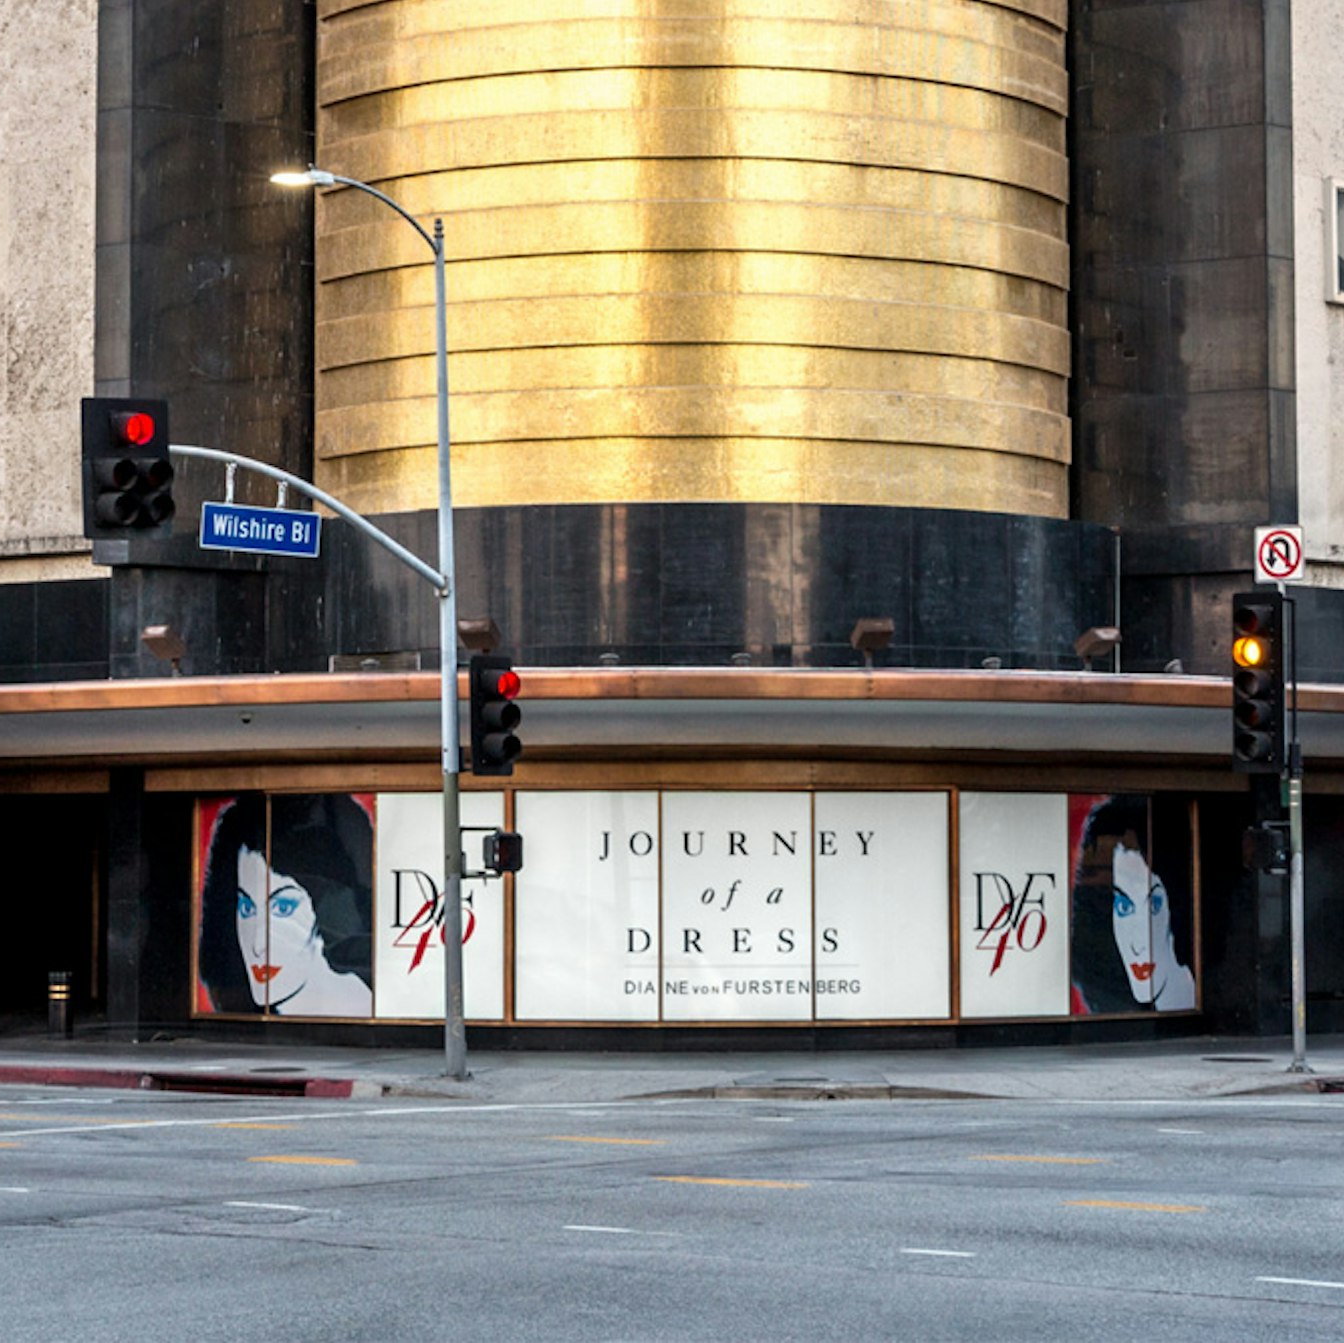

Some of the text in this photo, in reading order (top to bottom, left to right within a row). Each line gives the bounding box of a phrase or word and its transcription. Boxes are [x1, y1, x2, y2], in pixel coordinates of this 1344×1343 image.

[213, 514, 285, 542] Wilshire
[599, 831, 875, 861] JOURNEY
[701, 879, 783, 911] of a
[973, 872, 1055, 930] DVF
[627, 928, 838, 953] DRESS
[976, 894, 1047, 977] 40
[624, 980, 689, 994] DIANE
[723, 979, 861, 994] FURSTENBERG
